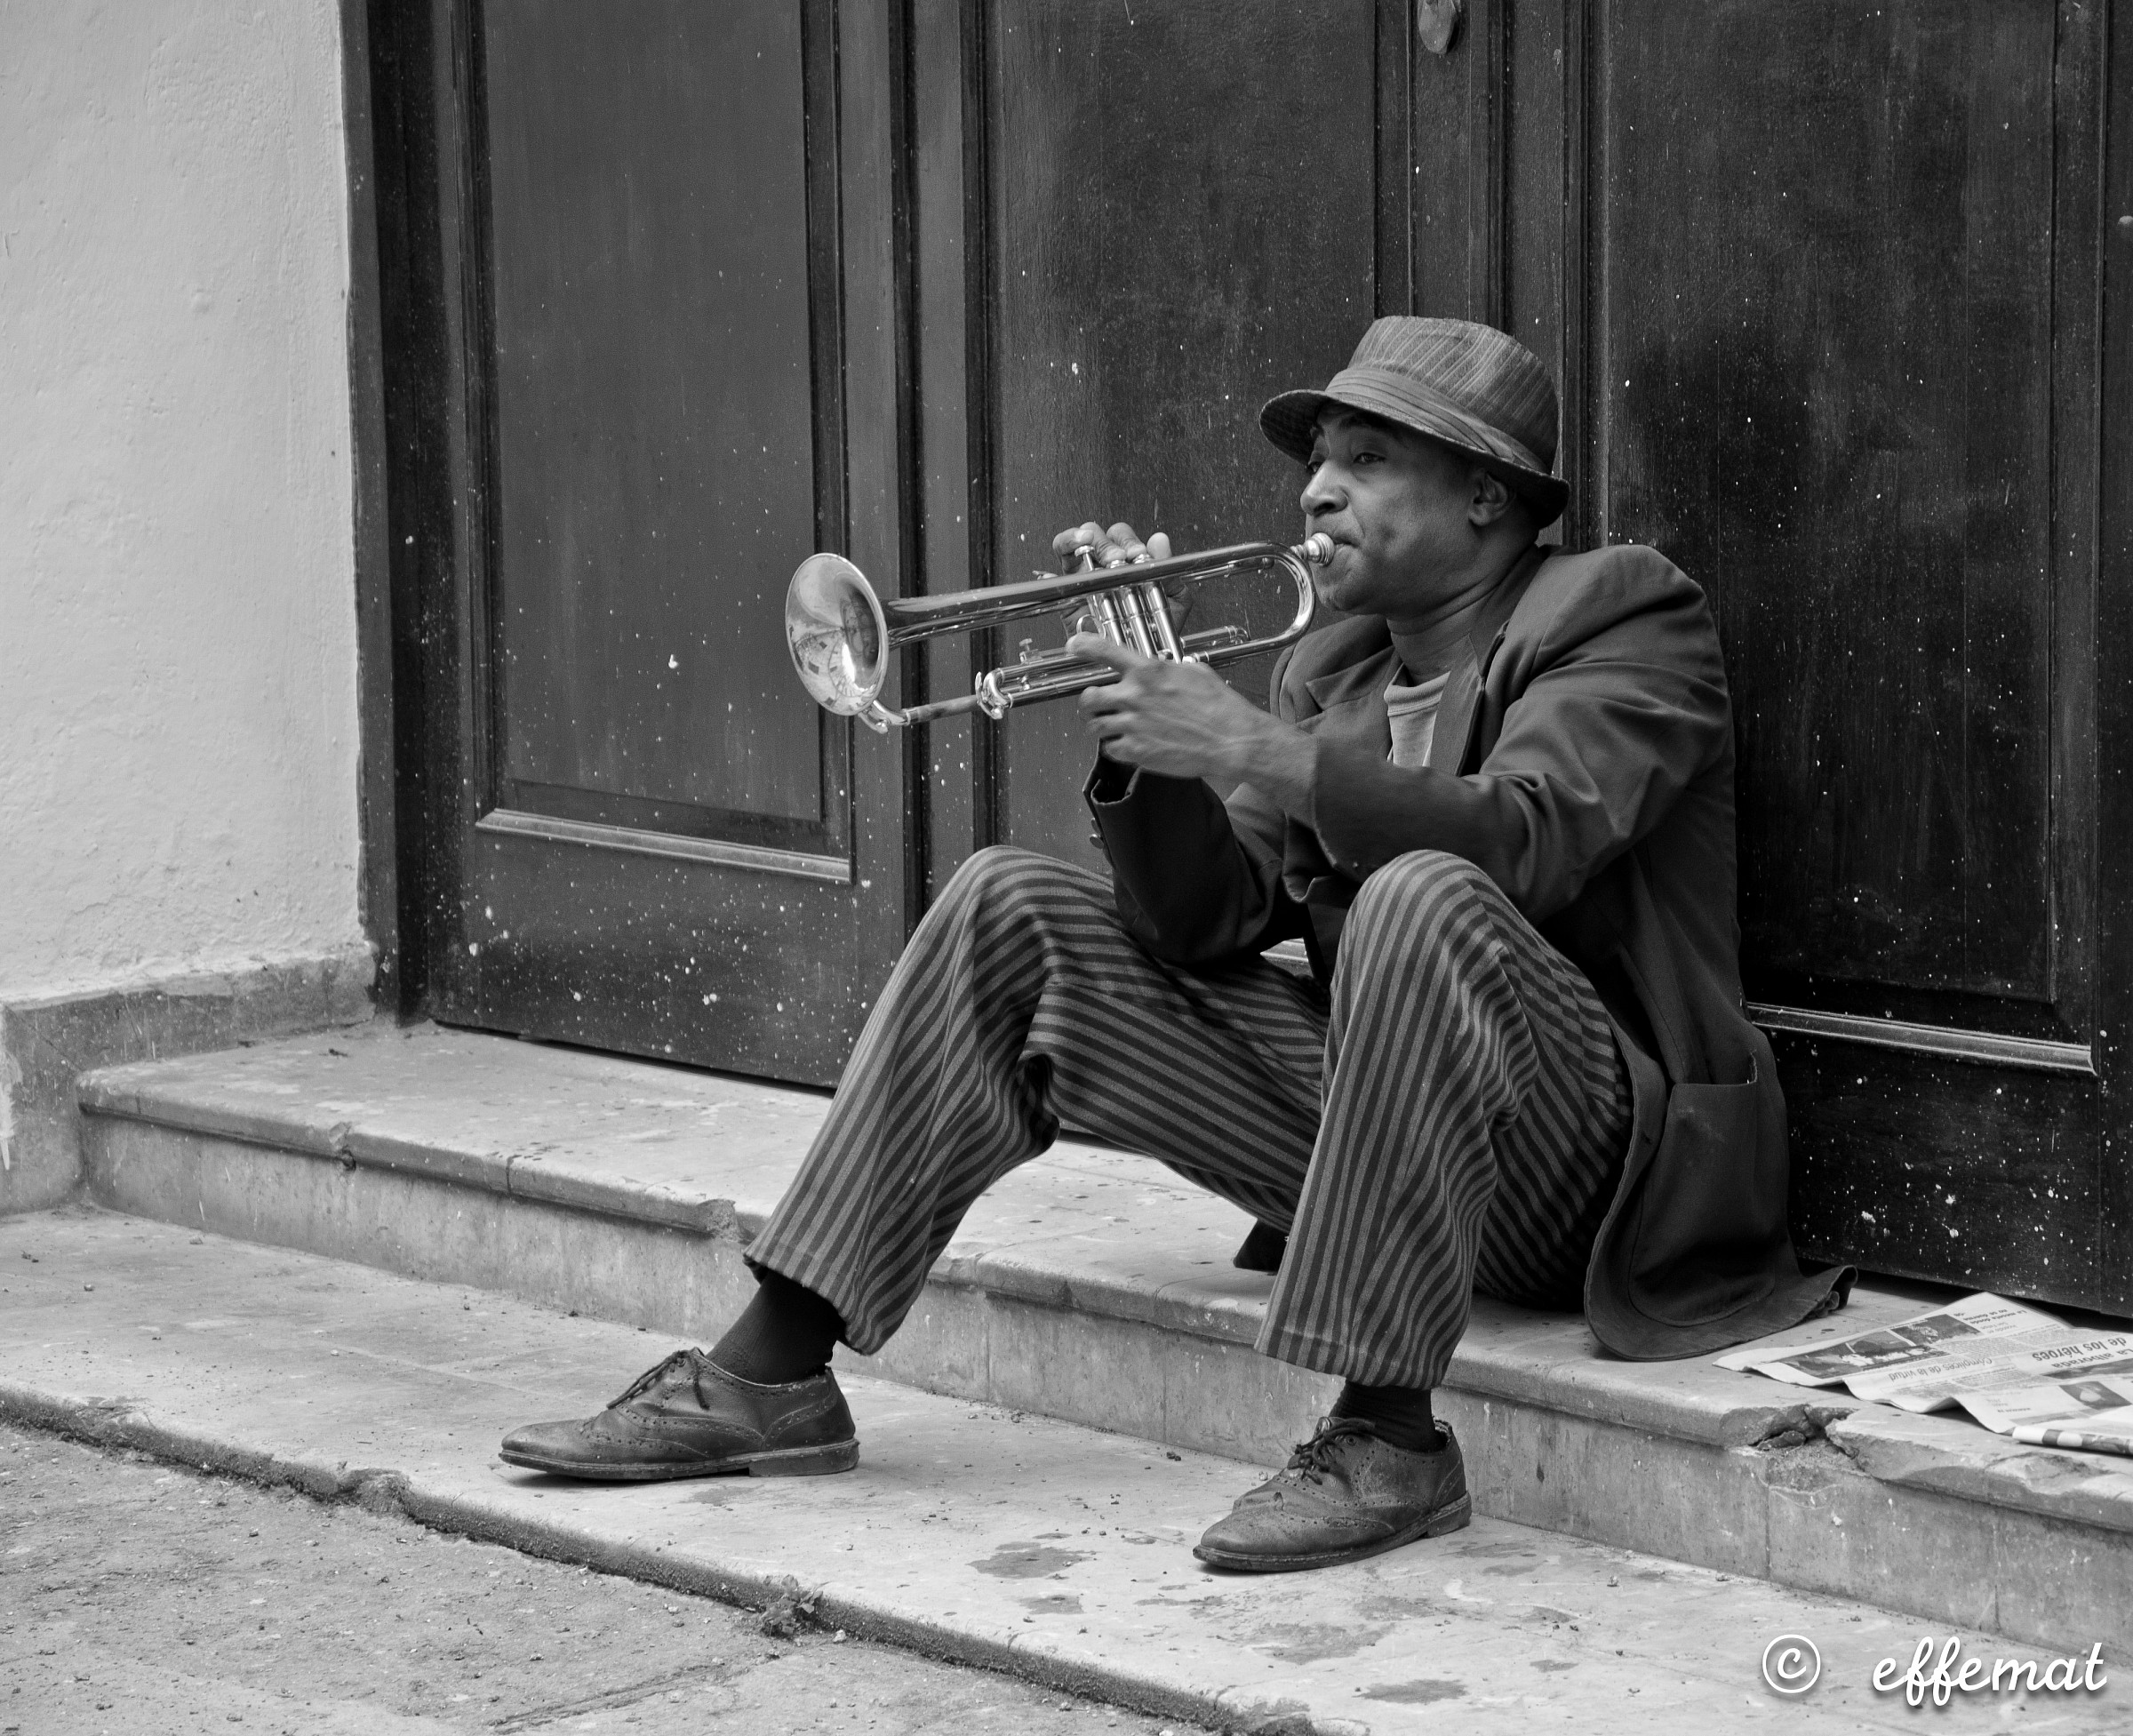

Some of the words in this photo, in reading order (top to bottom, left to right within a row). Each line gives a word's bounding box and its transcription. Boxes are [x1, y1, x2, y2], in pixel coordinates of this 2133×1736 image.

[2082, 1340, 2108, 1351] los
[2107, 1337, 2127, 1347] de
[2032, 1345, 2084, 1361] héroes
[1942, 1357, 1993, 1371] Cómplices
[2051, 1352, 2114, 1368] alborada
[1917, 1368, 1929, 1377] la
[1928, 1364, 1942, 1374] de
[1889, 1370, 1916, 1382] virtud
